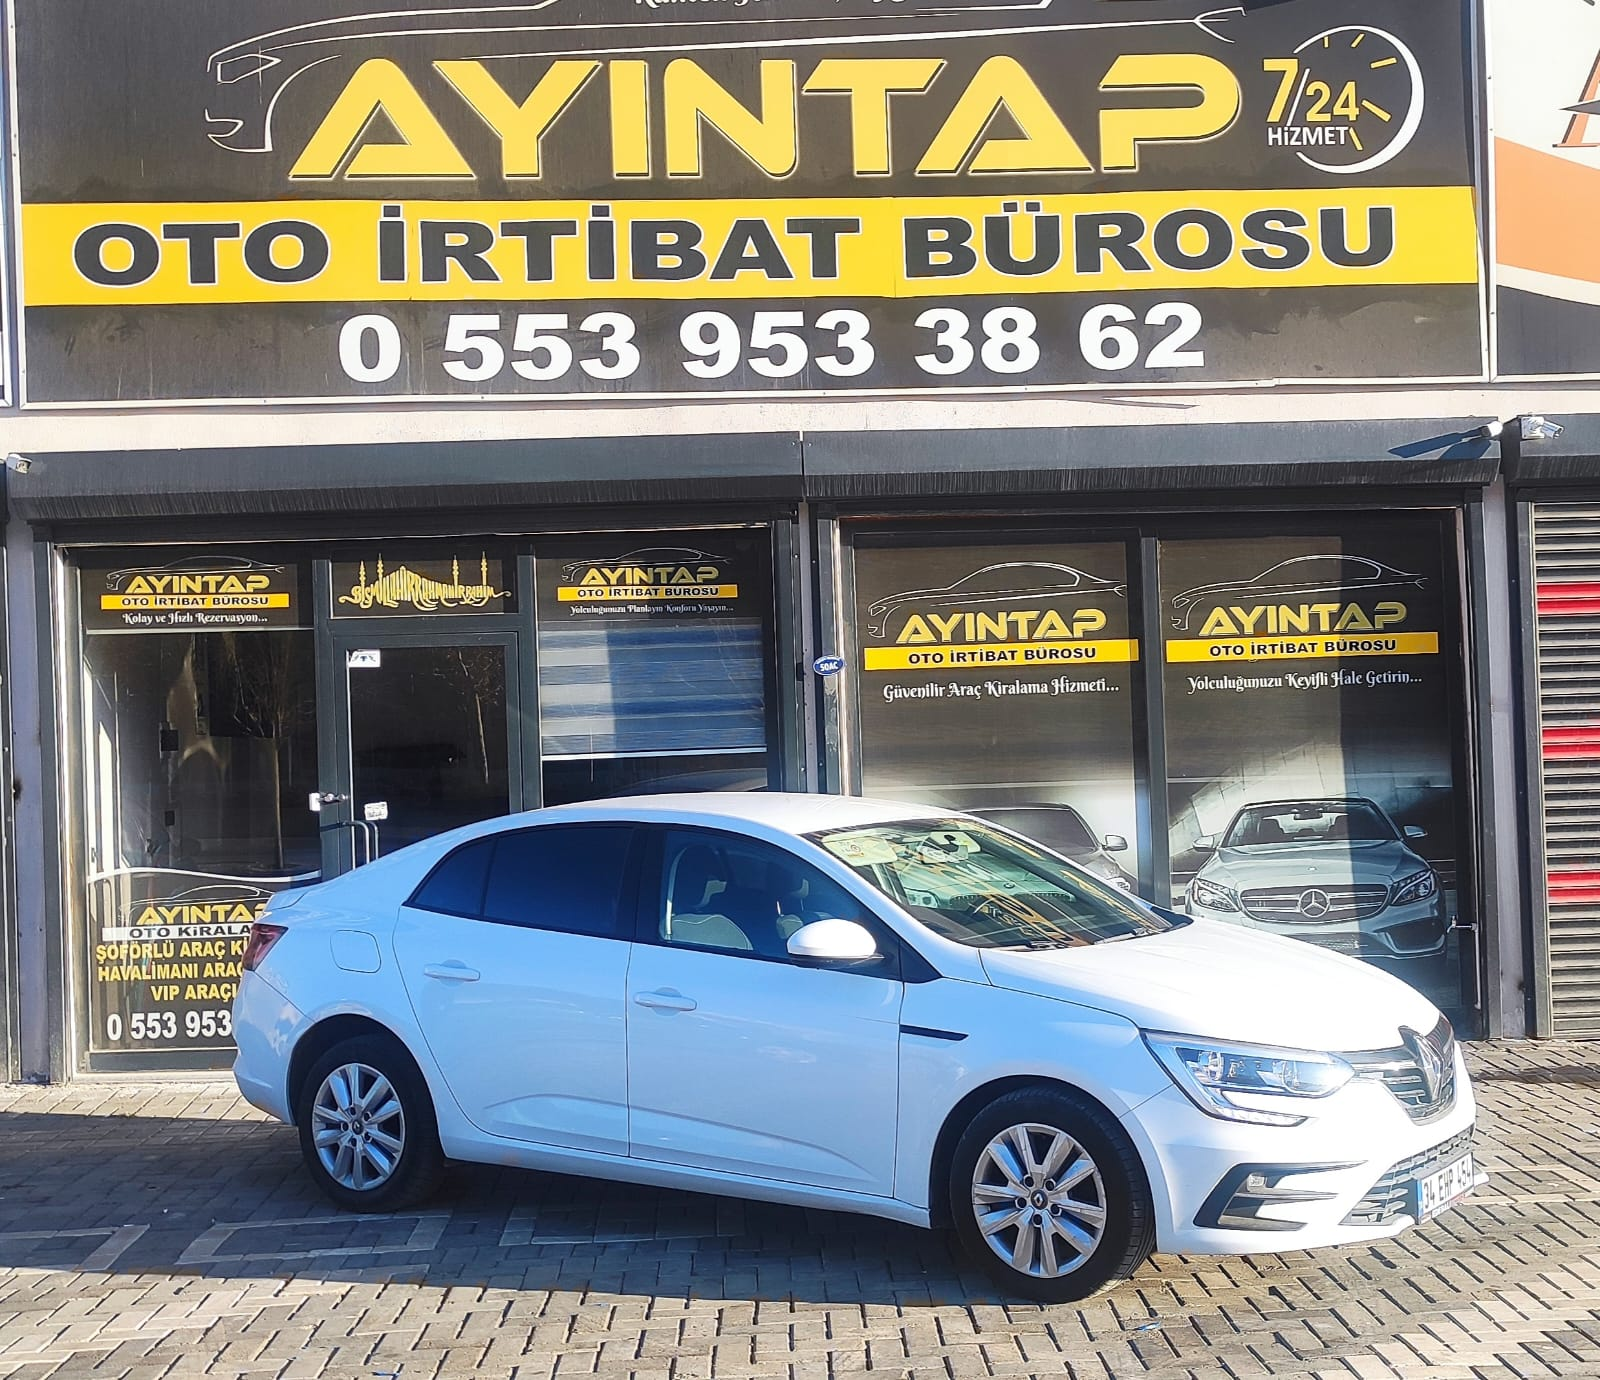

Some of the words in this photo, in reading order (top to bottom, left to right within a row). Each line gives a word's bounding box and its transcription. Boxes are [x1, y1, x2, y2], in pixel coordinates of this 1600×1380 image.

[1263, 58, 1360, 127] 7/24
[287, 53, 1241, 182] AYINTAP
[73, 219, 330, 287] OTO
[378, 202, 861, 284] İRTİBAT
[902, 201, 1394, 280] BÜROSU
[338, 313, 401, 383] 0
[442, 312, 641, 381] 553
[679, 309, 875, 379] 953
[914, 306, 1040, 375] 38
[1078, 302, 1205, 370] 62
[125, 574, 271, 594] AYINTAP
[579, 566, 719, 585] AYINTAP
[121, 595, 149, 607] OTO
[154, 594, 207, 606] İRTİBAT
[212, 594, 269, 606] BÜROSU
[577, 588, 604, 598] OTO
[608, 587, 660, 597] İRTİBAT
[664, 585, 719, 597] BÜROSU
[122, 612, 153, 625] Kolay
[154, 614, 167, 624] ve
[168, 612, 193, 625] Hızlı
[896, 608, 1107, 644] AYINTAP
[1199, 601, 1408, 636] AYINTAP
[908, 652, 944, 665] OTO
[950, 649, 1017, 663] İRTİBAT
[1024, 647, 1096, 661] BÜROSU
[1209, 644, 1244, 657] OTO
[1250, 641, 1317, 655] İRTİBAT
[1324, 639, 1396, 653] BÜROSU
[883, 681, 946, 703] Güvenilir
[947, 681, 981, 700] Araç
[984, 677, 1048, 698] Kiralama
[1187, 675, 1282, 695] Yolculuğumuzu
[1284, 671, 1328, 690] Keyifli
[1330, 669, 1363, 687] Hale
[129, 928, 171, 939] OTO
[96, 940, 175, 965] ŞOFÖRLÜ
[180, 940, 226, 960] ARAÇ
[98, 959, 198, 982] HAVALİMANI
[150, 985, 180, 1001] VIP
[106, 1013, 122, 1041] 0
[130, 1011, 177, 1040] 553
[185, 1009, 232, 1038] 953
[1423, 1179, 1435, 1209] 34
[1438, 1168, 1454, 1201] EHP
[1457, 1158, 1471, 1189] 454
